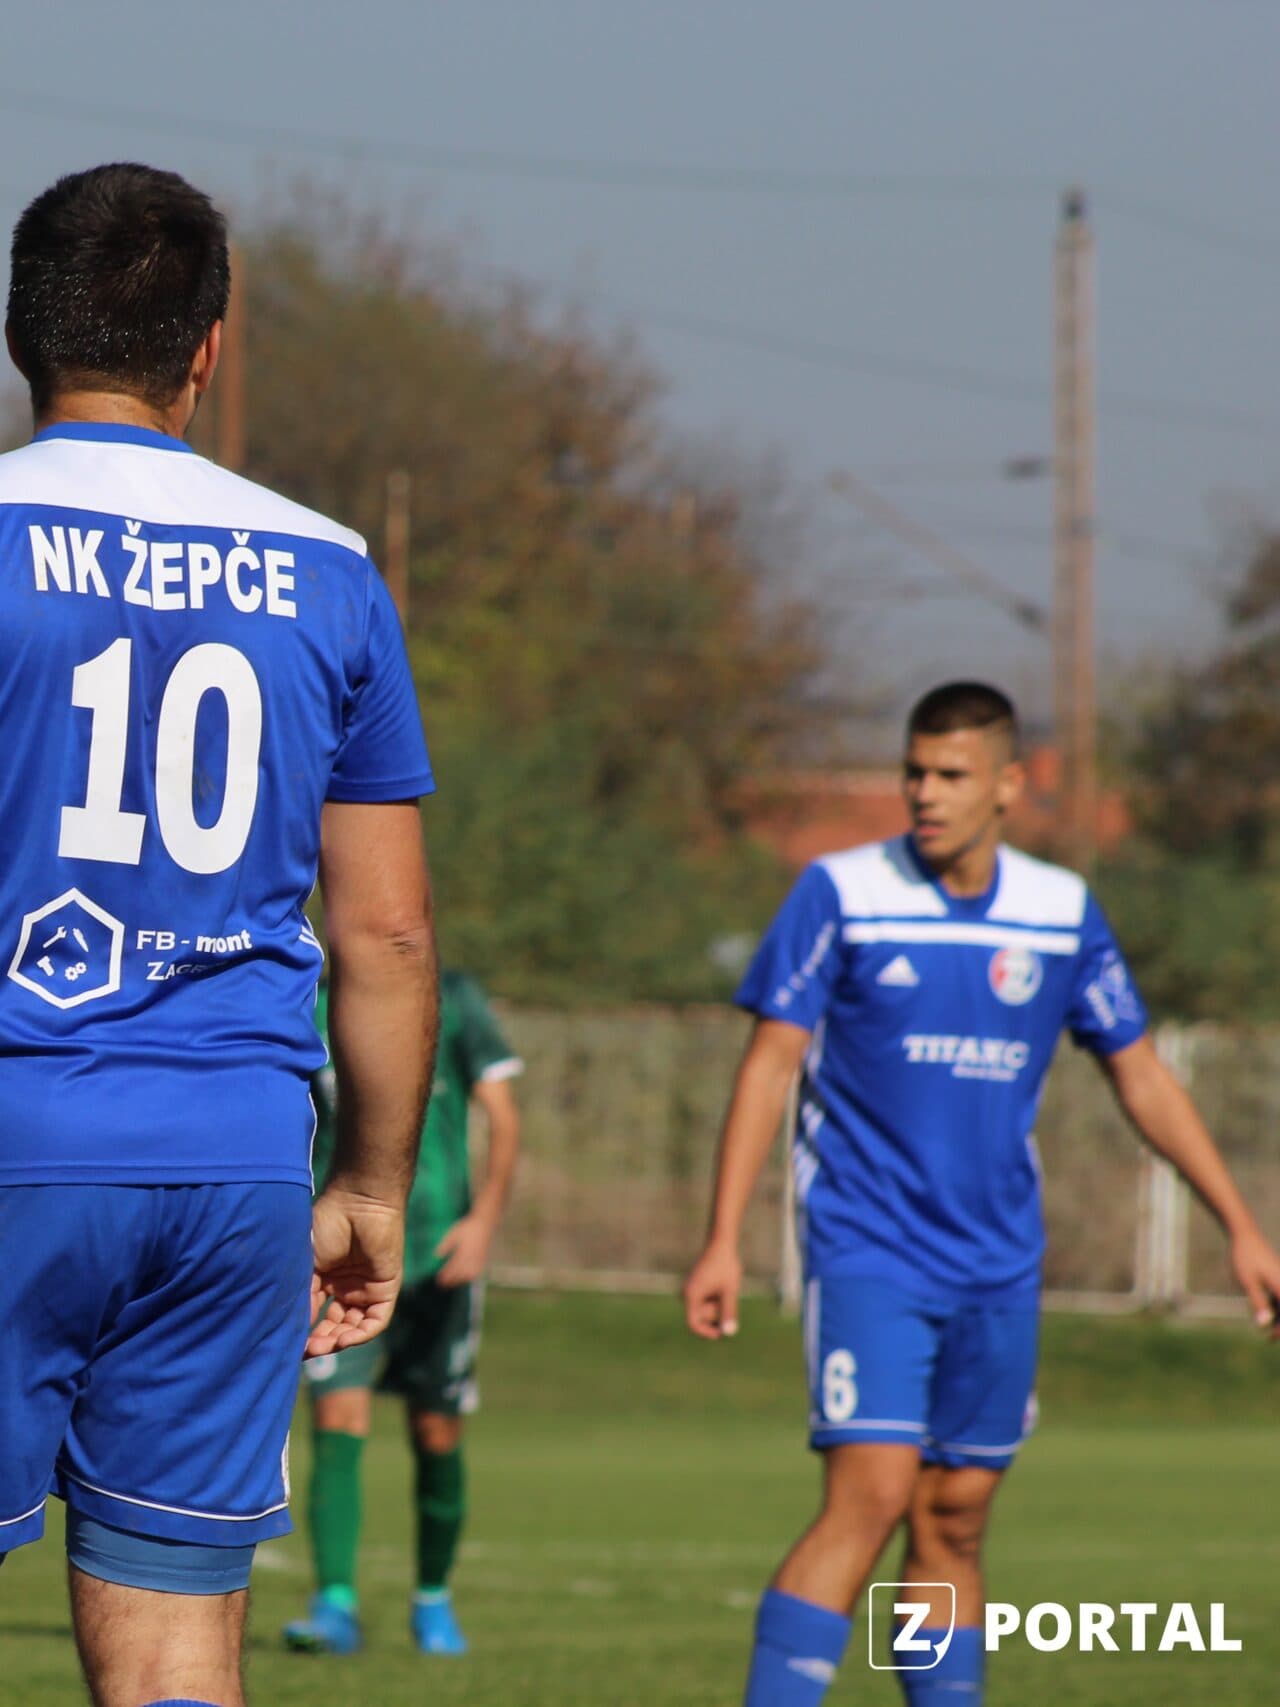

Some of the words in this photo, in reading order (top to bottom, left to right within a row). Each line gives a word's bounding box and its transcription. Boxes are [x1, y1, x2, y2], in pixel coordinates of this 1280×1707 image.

[28, 524, 111, 598] NK
[121, 519, 297, 619] ŽEPČE
[57, 637, 263, 875] 10
[136, 929, 176, 951] FB
[195, 929, 253, 954] mont
[823, 1349, 858, 1422] 6
